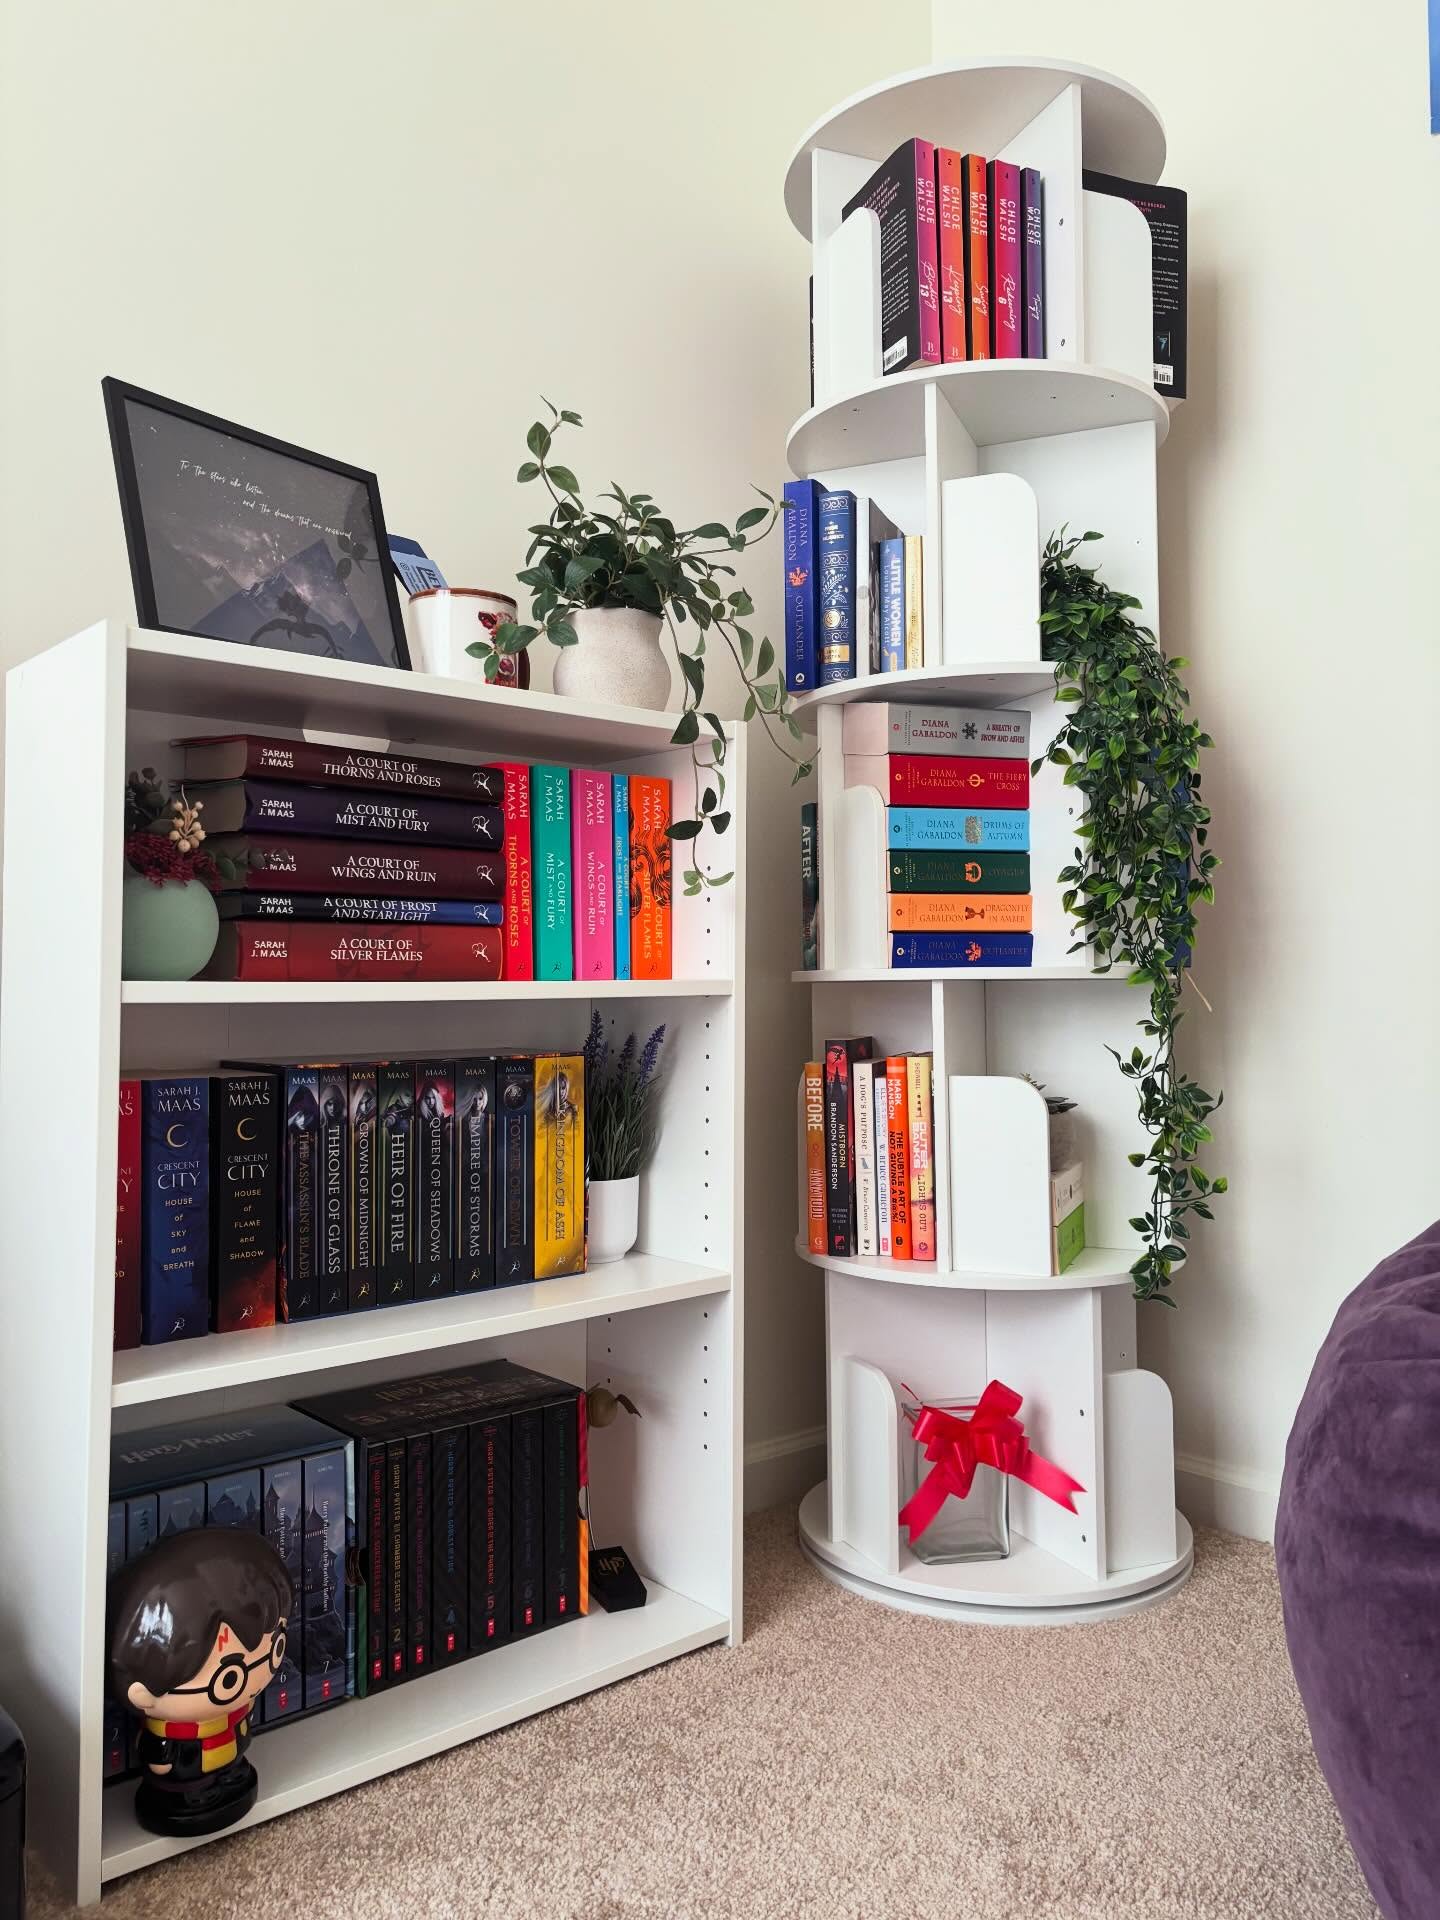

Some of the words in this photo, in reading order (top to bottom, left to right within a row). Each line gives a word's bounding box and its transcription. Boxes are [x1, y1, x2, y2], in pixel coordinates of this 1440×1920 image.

[948, 158, 952, 166] 2
[926, 180, 935, 224] CHLOE
[942, 185, 951, 228] WALSH
[951, 187, 960, 230] CHLOE
[970, 192, 978, 235] WALSH
[978, 193, 988, 236] CHLOE
[1008, 200, 1016, 244] CHLOE
[920, 285, 929, 298] 13
[921, 261, 938, 311] Binding
[944, 290, 952, 303] 13
[800, 508, 808, 547] DIANA
[890, 557, 901, 594] LITTLE
[795, 596, 804, 661] OUTLANDER
[890, 598, 901, 646] WOMEN
[922, 720, 949, 728] DIANA
[912, 730, 958, 738] GABALDON
[262, 748, 292, 760] SARAH
[268, 758, 294, 768] MAAS
[346, 754, 354, 766] A
[357, 756, 400, 771] COURT
[402, 762, 418, 773] OF
[322, 764, 375, 780] THORNS
[376, 770, 404, 782] AND
[406, 774, 441, 788] ROSES
[930, 769, 956, 778] DIANA
[988, 772, 1004, 780] THE
[1006, 773, 1026, 781] FIERY
[920, 780, 965, 788] GABALDON
[996, 782, 1020, 790] CROSS
[262, 799, 292, 809] SARAH
[518, 774, 528, 818] SARAH
[556, 778, 564, 820] SARAH
[596, 782, 604, 824] SARAH
[346, 802, 354, 814] A
[357, 804, 400, 818] COURT
[402, 808, 418, 820] OF
[654, 789, 662, 829] SARAH
[336, 814, 366, 826] MIST
[368, 816, 396, 828] AND
[398, 820, 430, 832] FURY
[927, 820, 954, 828] DIANA
[918, 832, 962, 840] GABALDON
[508, 835, 518, 886] THORNS
[802, 825, 812, 878] AFTER
[346, 856, 356, 866] A
[358, 856, 402, 868] COURT
[404, 860, 420, 870] OF
[332, 866, 376, 878] WINGS
[378, 870, 404, 880] AND
[406, 871, 437, 882] RUIN
[260, 898, 292, 906] SARAH
[324, 898, 332, 906] A
[335, 898, 378, 909] COURT
[382, 900, 398, 910] OF
[400, 901, 438, 912] FROST
[928, 904, 956, 912] DIANA
[986, 904, 1029, 912] DRAGONFLY
[331, 909, 360, 918] AND
[362, 910, 430, 921] STARLIGHT
[920, 914, 964, 922] GABALDON
[510, 906, 518, 946] ROSES
[254, 940, 285, 948] SARAH
[339, 938, 348, 949] A
[350, 938, 394, 950] COURT
[396, 940, 413, 950] OF
[330, 950, 374, 960] SILVER
[376, 950, 423, 961] FLAMES
[352, 1072, 376, 1080] MAAS
[426, 1068, 447, 1076] MAAS
[466, 1068, 486, 1076] MAAS
[228, 1093, 270, 1107] MAAS
[894, 1079, 902, 1106] MARK
[158, 1098, 200, 1112] MAAS
[807, 1077, 822, 1132] BEFORE
[830, 1102, 838, 1140] BRANDON
[860, 1113, 868, 1150] PURPOSE
[896, 1131, 904, 1150] THE
[360, 1122, 368, 1174] CROWN
[430, 1117, 440, 1166] QUEEN
[470, 1116, 480, 1170] EMPIRE
[556, 1108, 566, 1185] KINGDOM
[912, 1122, 920, 1168] BANKS
[918, 1122, 928, 1168] OUTER
[228, 1154, 268, 1164] CRESCENT
[328, 1126, 340, 1195] THRONE
[392, 1133, 404, 1178] HEIR
[158, 1160, 200, 1172] CRESCENT
[228, 1164, 268, 1180] CITY
[158, 1172, 200, 1190] CITY
[360, 1178, 368, 1194] OF
[430, 1168, 440, 1187] OF
[470, 1172, 480, 1194] OF
[234, 1189, 262, 1198] HOUSE
[392, 1183, 404, 1208] OF
[556, 1188, 565, 1206] OF
[918, 1174, 926, 1211] LIGHTS
[165, 1198, 192, 1206] HOUSE
[328, 1199, 340, 1220] OF
[174, 1214, 184, 1222] of
[234, 1220, 261, 1228] FLAME
[430, 1190, 440, 1262] SHADOWS
[470, 1196, 480, 1257] STORMS
[556, 1210, 565, 1240] ASH
[899, 1211, 906, 1224] OF
[919, 1213, 927, 1232] OUT
[171, 1230, 186, 1238] SKY
[360, 1198, 368, 1268] MIDNIGHT
[392, 1214, 404, 1252] FIRE
[171, 1246, 186, 1254] and
[230, 1250, 264, 1260] SHADOW
[328, 1224, 340, 1274] GLASS
[164, 1261, 194, 1270] BREATH
[120, 1443, 182, 1464] Harry
[182, 1428, 256, 1448] Potter
[393, 1628, 400, 1642] 2
[324, 1661, 330, 1673] 7
[280, 1670, 287, 1683] 6
[112, 1728, 118, 1742] 2
